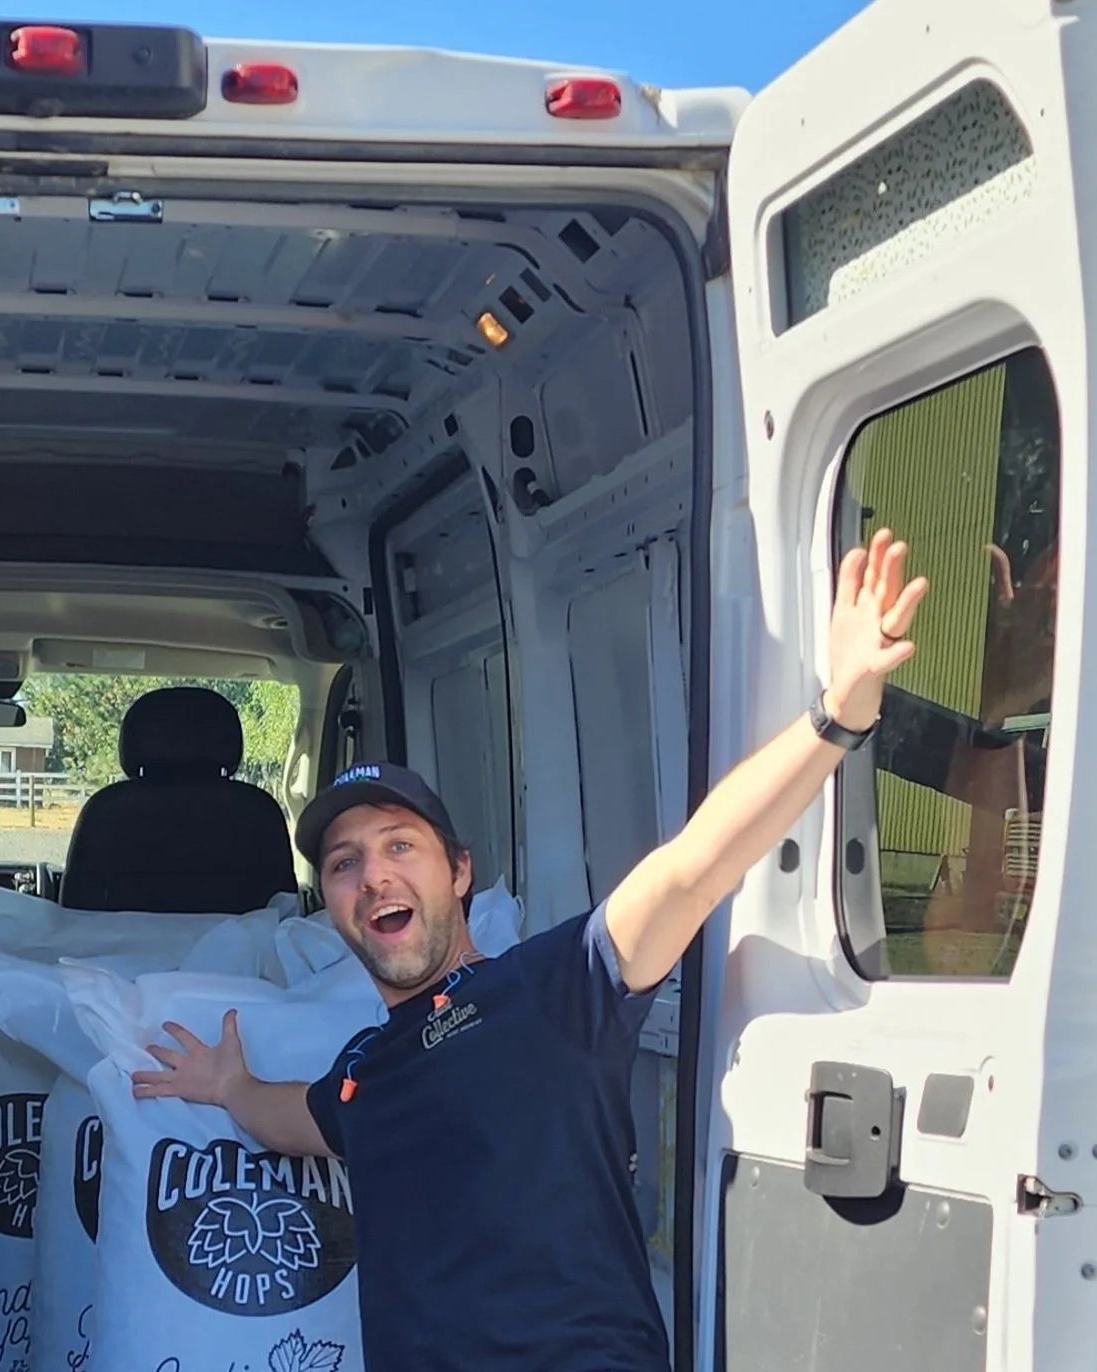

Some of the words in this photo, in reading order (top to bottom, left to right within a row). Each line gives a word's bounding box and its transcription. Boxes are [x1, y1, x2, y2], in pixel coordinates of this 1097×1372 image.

[422, 1003, 478, 1049] Collective
[157, 1143, 354, 1215] COLEMAN
[210, 1267, 295, 1305] HOPS
